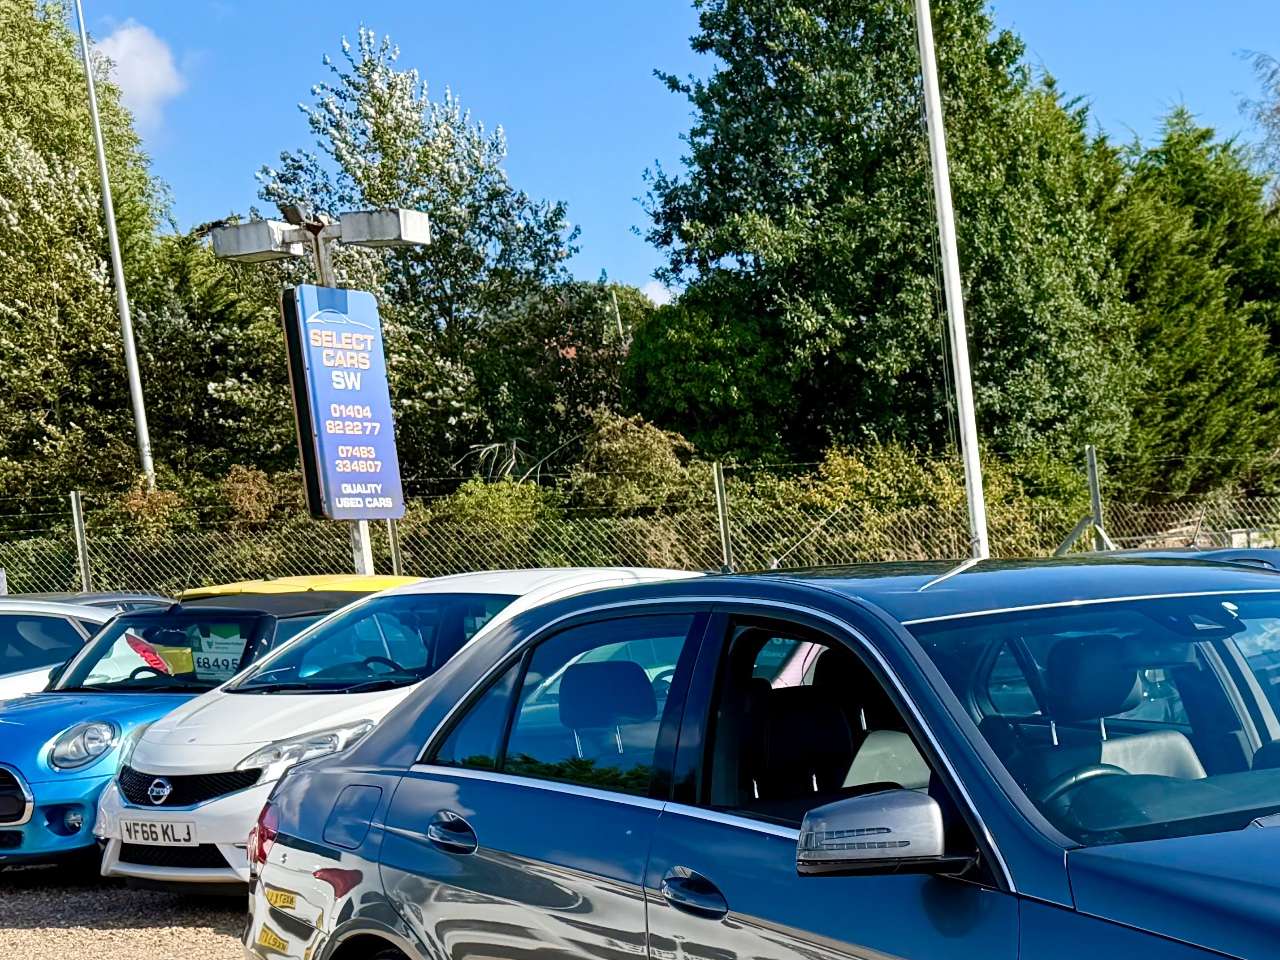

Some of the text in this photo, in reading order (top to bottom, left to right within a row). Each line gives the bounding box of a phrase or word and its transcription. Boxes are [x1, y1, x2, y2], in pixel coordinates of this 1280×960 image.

[310, 329, 374, 351] SELECT
[322, 350, 371, 370] CARS
[331, 370, 361, 391] SW
[330, 404, 372, 418] 01404
[341, 483, 382, 494] QUALITY
[335, 497, 392, 508] USED CARS
[160, 823, 192, 843] KLJ
